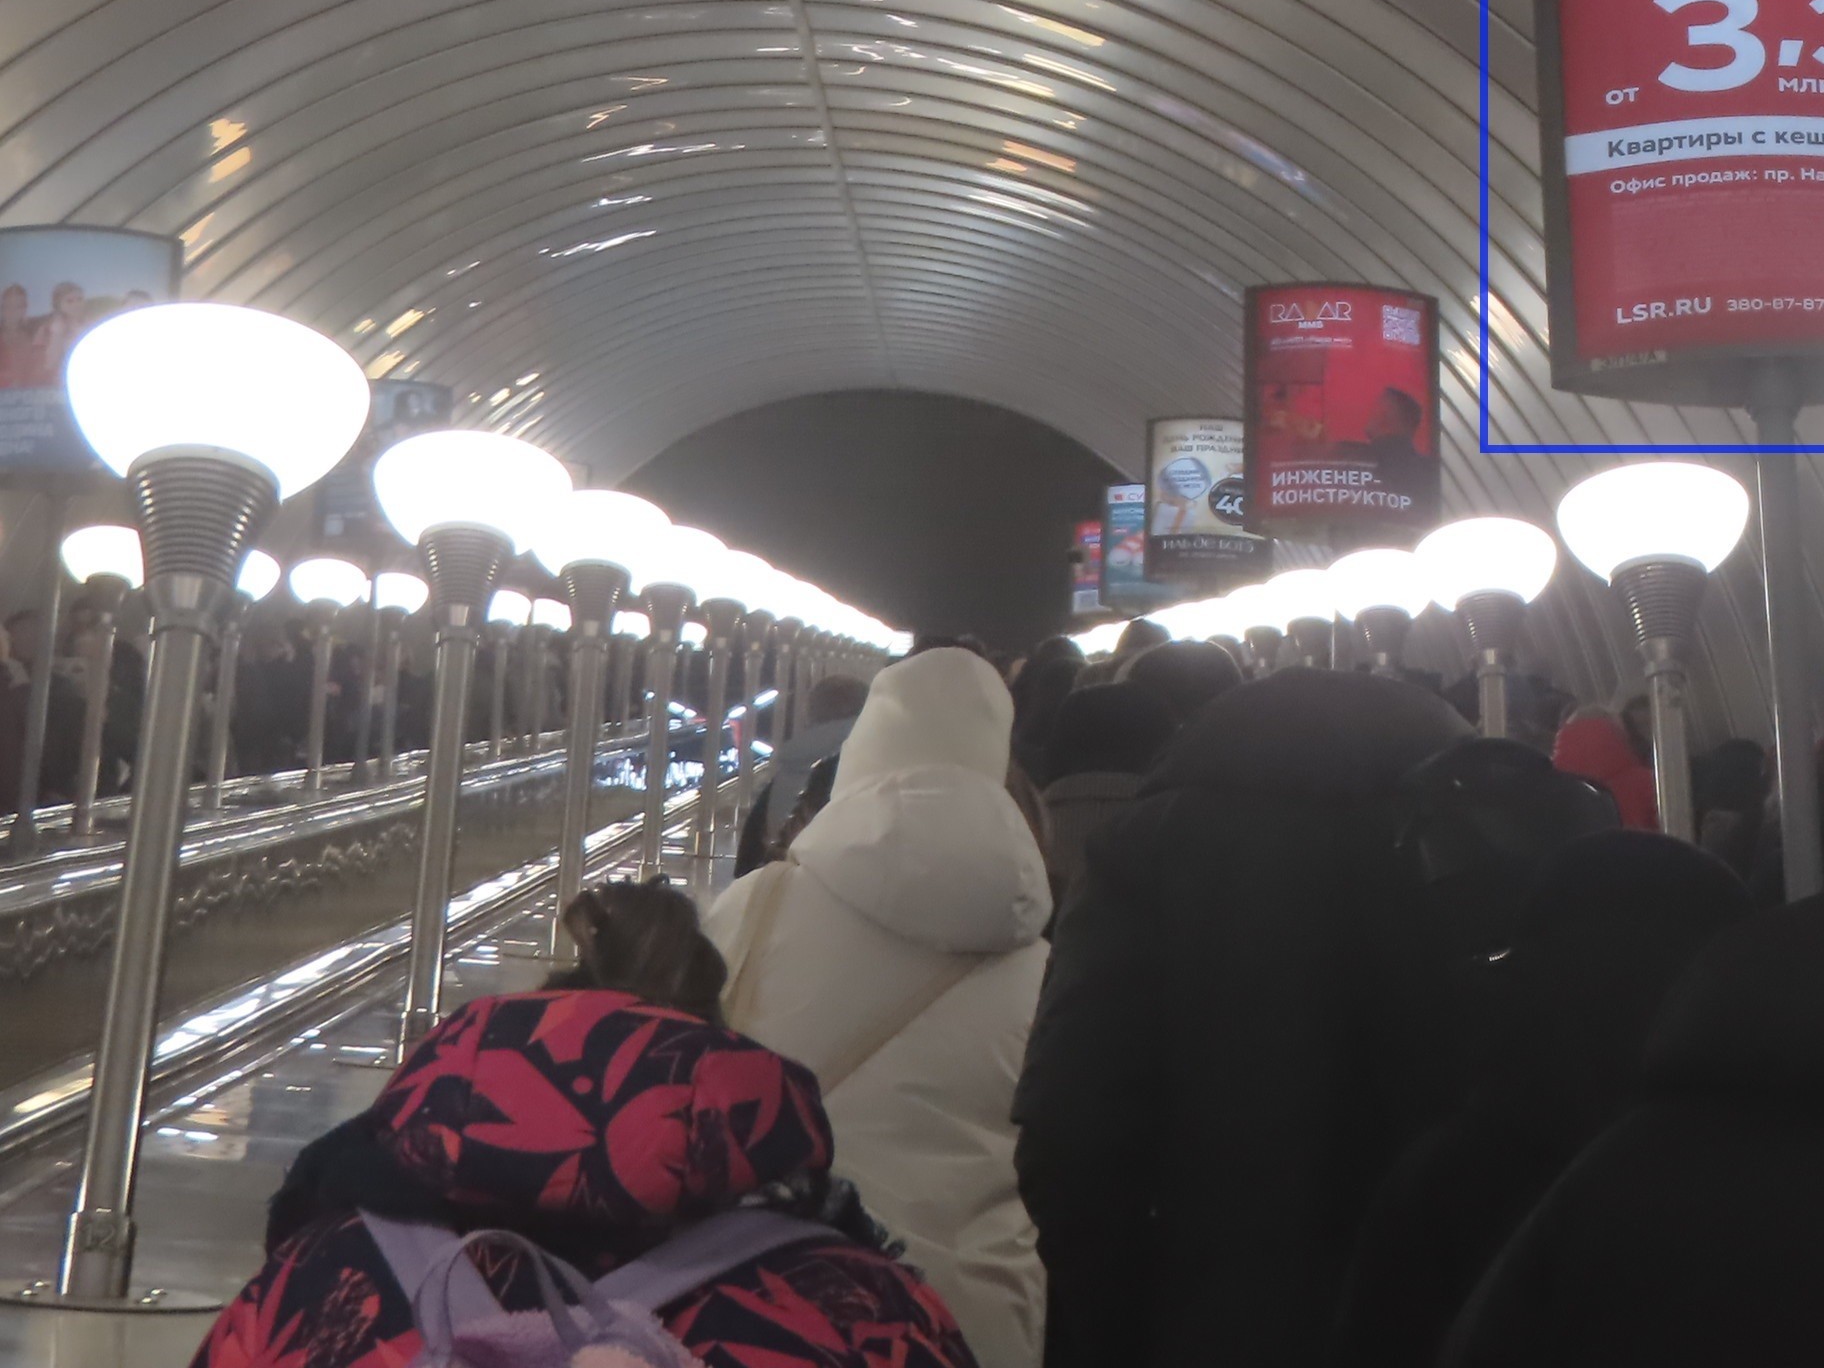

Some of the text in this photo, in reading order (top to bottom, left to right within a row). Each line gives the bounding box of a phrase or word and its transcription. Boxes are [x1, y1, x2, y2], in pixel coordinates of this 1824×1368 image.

[1605, 87, 1640, 106] от
[1607, 131, 1744, 158] Квартиры
[1751, 130, 1767, 145] с
[1610, 174, 1667, 194] Офис
[1671, 167, 1759, 188] продаж:
[1763, 168, 1796, 184] пр.
[1616, 297, 1712, 324] LSR.RU
[1271, 469, 1382, 487] ИНЖЕНЕР-
[1272, 488, 1412, 509] КОНСТРУКТОР
